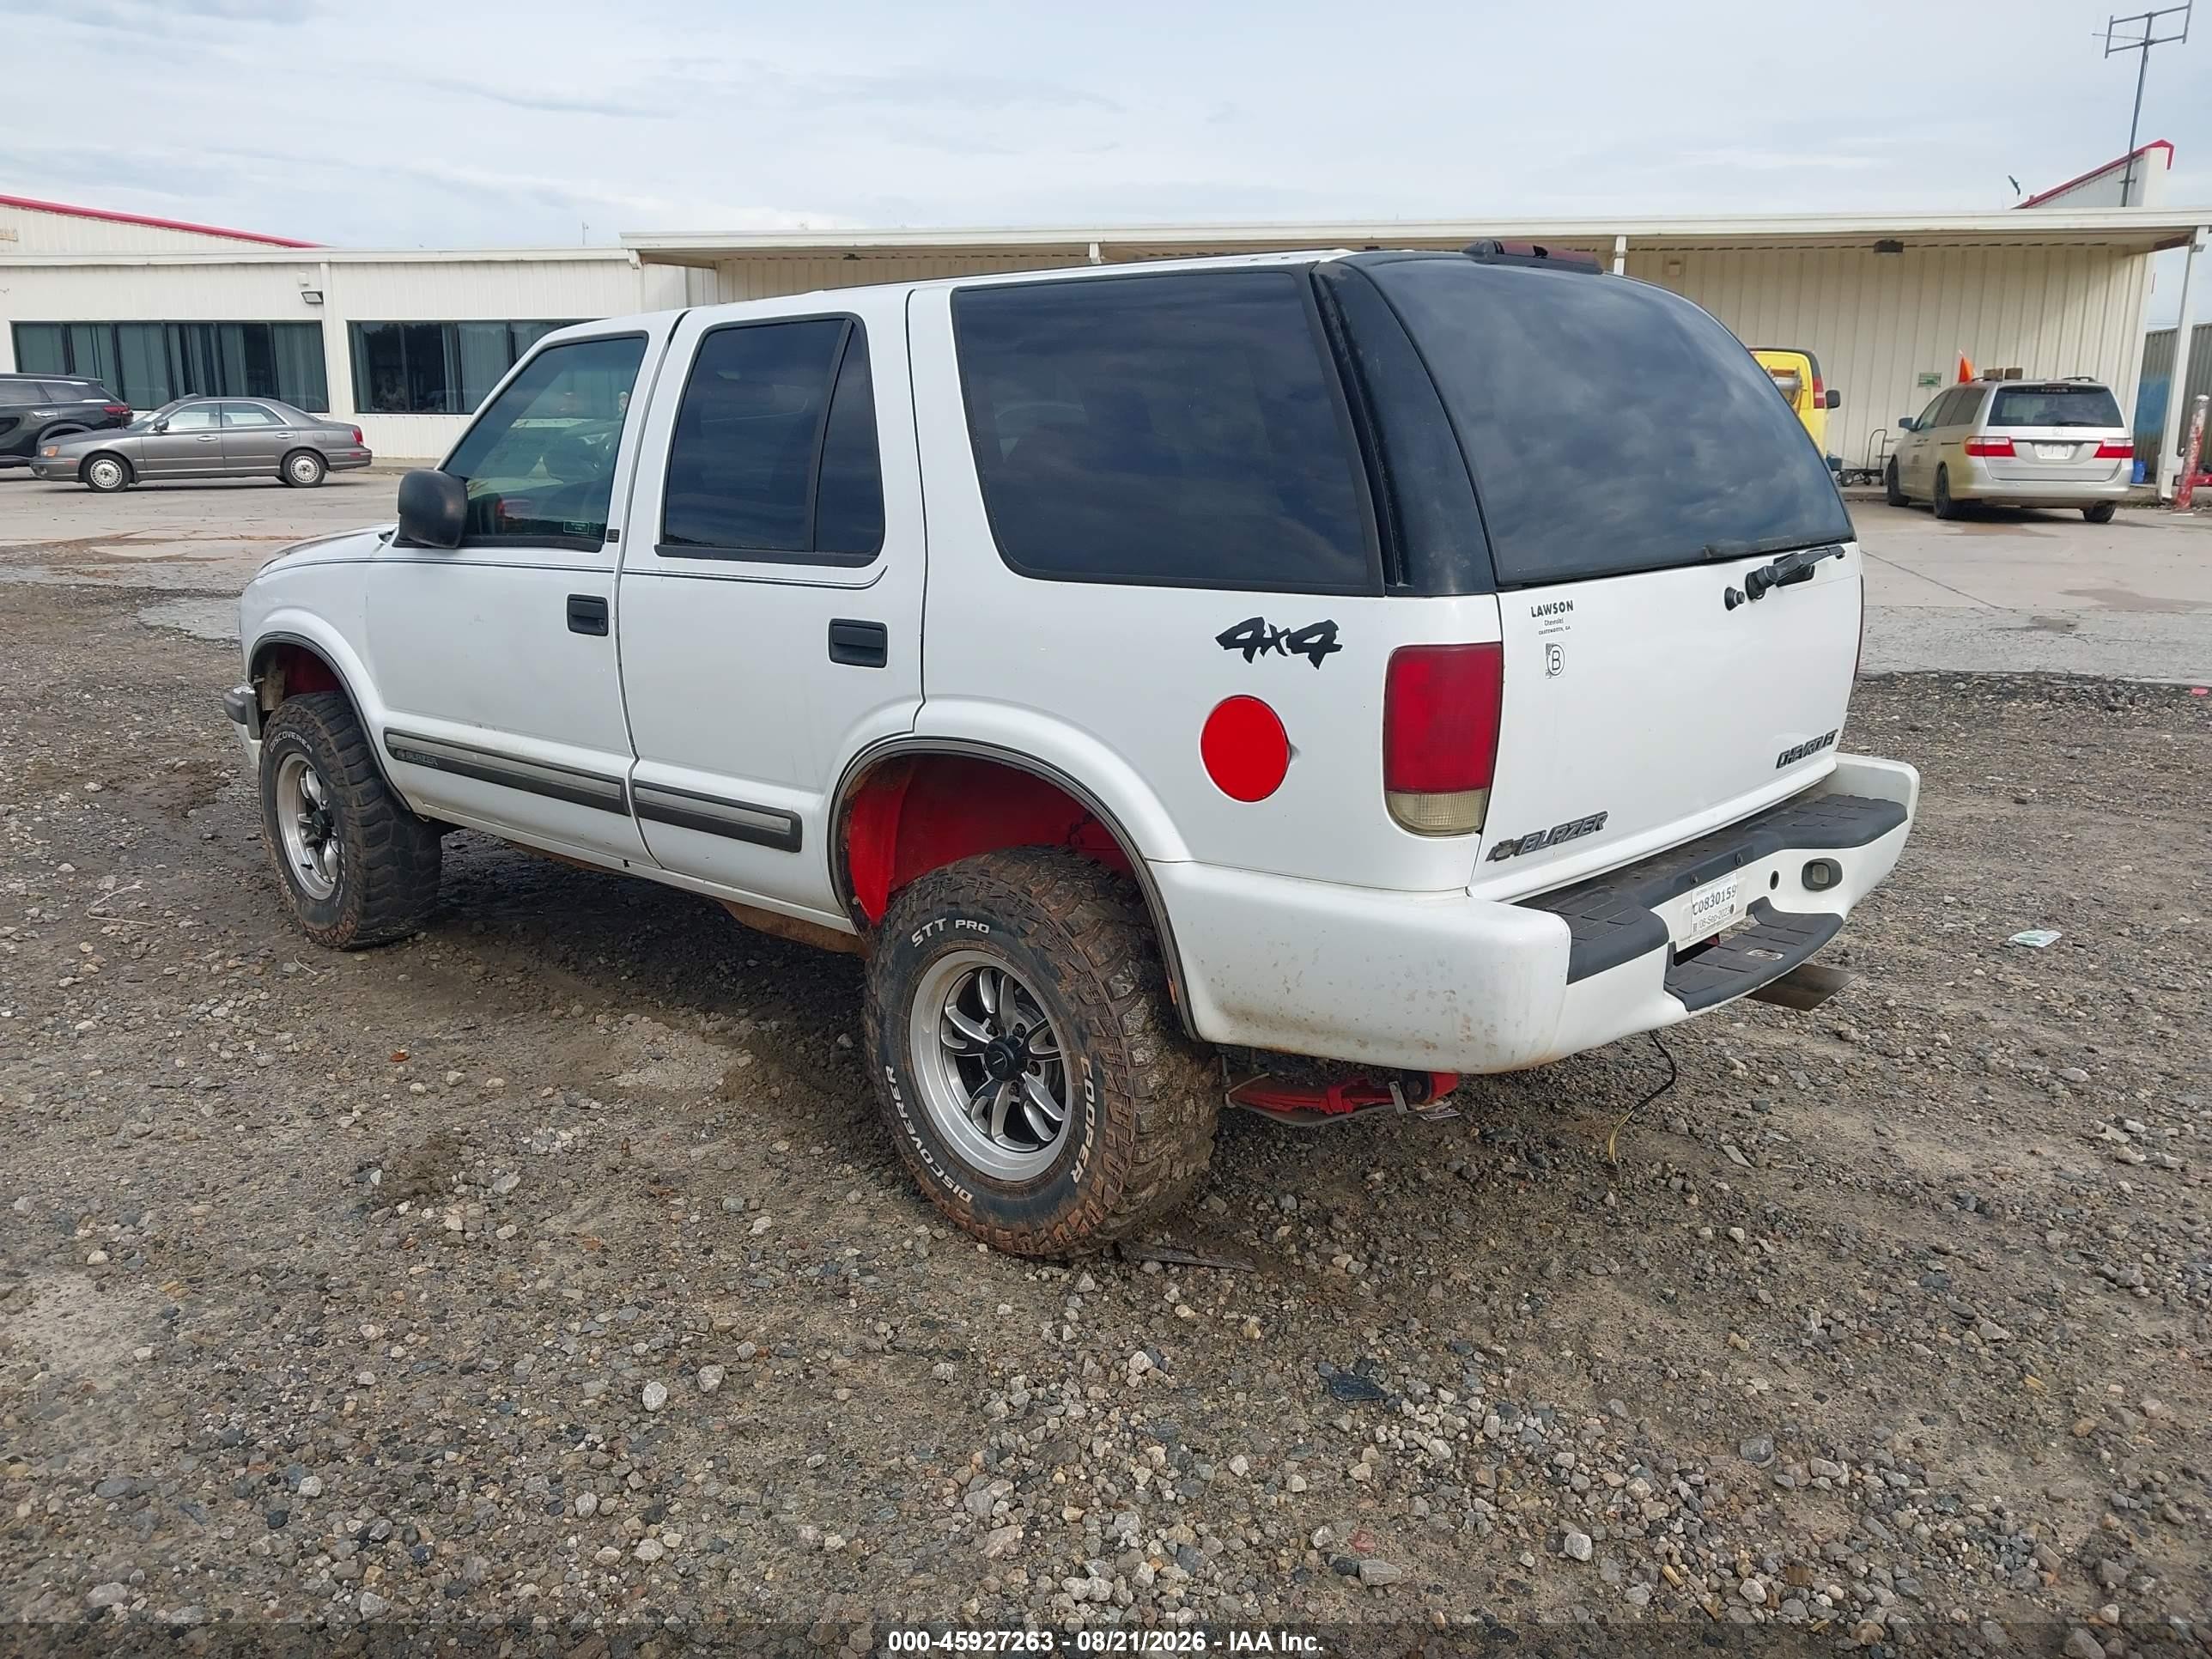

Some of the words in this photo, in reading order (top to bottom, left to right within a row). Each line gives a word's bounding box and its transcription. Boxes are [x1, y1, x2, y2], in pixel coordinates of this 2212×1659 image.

[1530, 599, 1574, 618] LAWSON
[269, 731, 313, 754] DISCOVERER
[1776, 728, 1838, 769] CHEVROLET
[1518, 810, 1609, 856] BLAZER
[1692, 884, 1738, 915] C0830159
[911, 917, 947, 948] STT
[955, 919, 990, 934] PRO
[885, 1065, 974, 1203] DISCOVERER
[1070, 1056, 1096, 1183] COOPER
